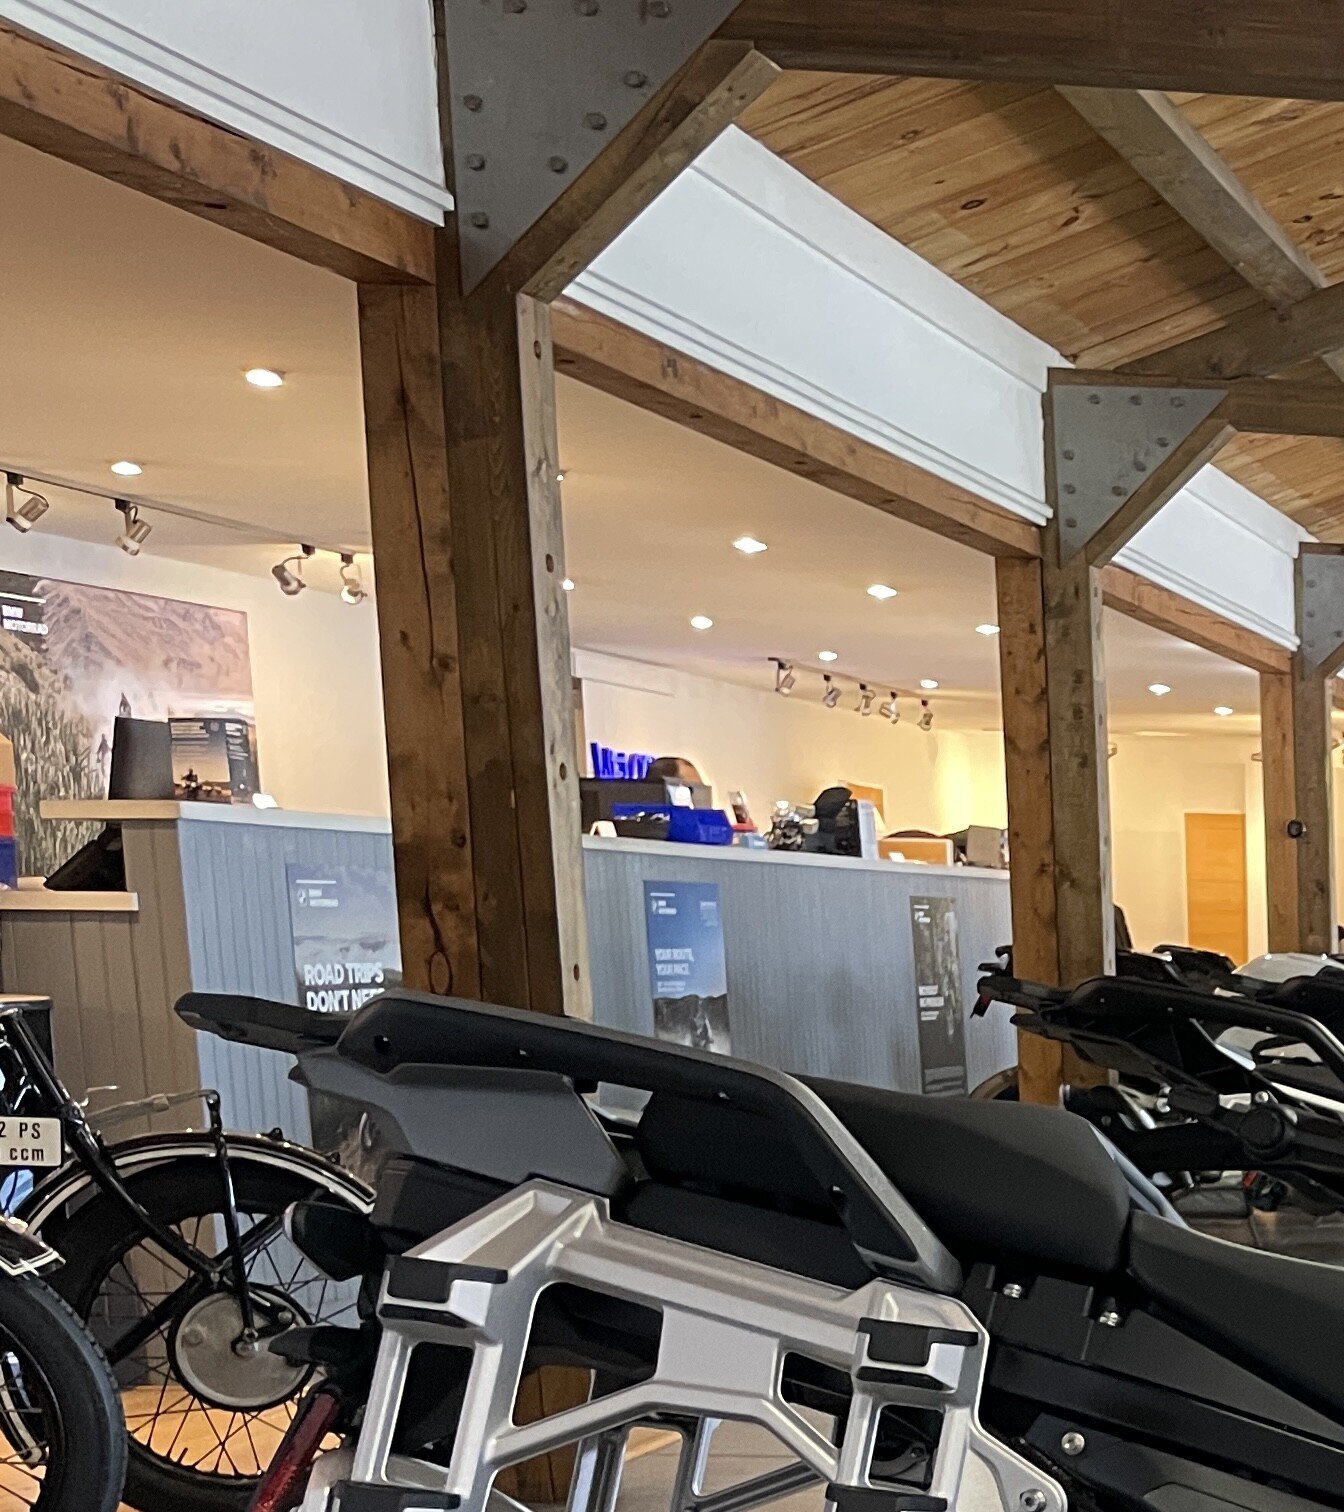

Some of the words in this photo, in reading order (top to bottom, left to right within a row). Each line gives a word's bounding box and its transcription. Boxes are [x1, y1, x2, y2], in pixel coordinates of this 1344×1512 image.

[303, 963, 345, 986] ROAD
[345, 962, 384, 984] TRIPS
[306, 989, 350, 1013] DON'T
[351, 987, 386, 1010] NE
[19, 1122, 41, 1139] PS
[9, 1147, 45, 1162] ccm
